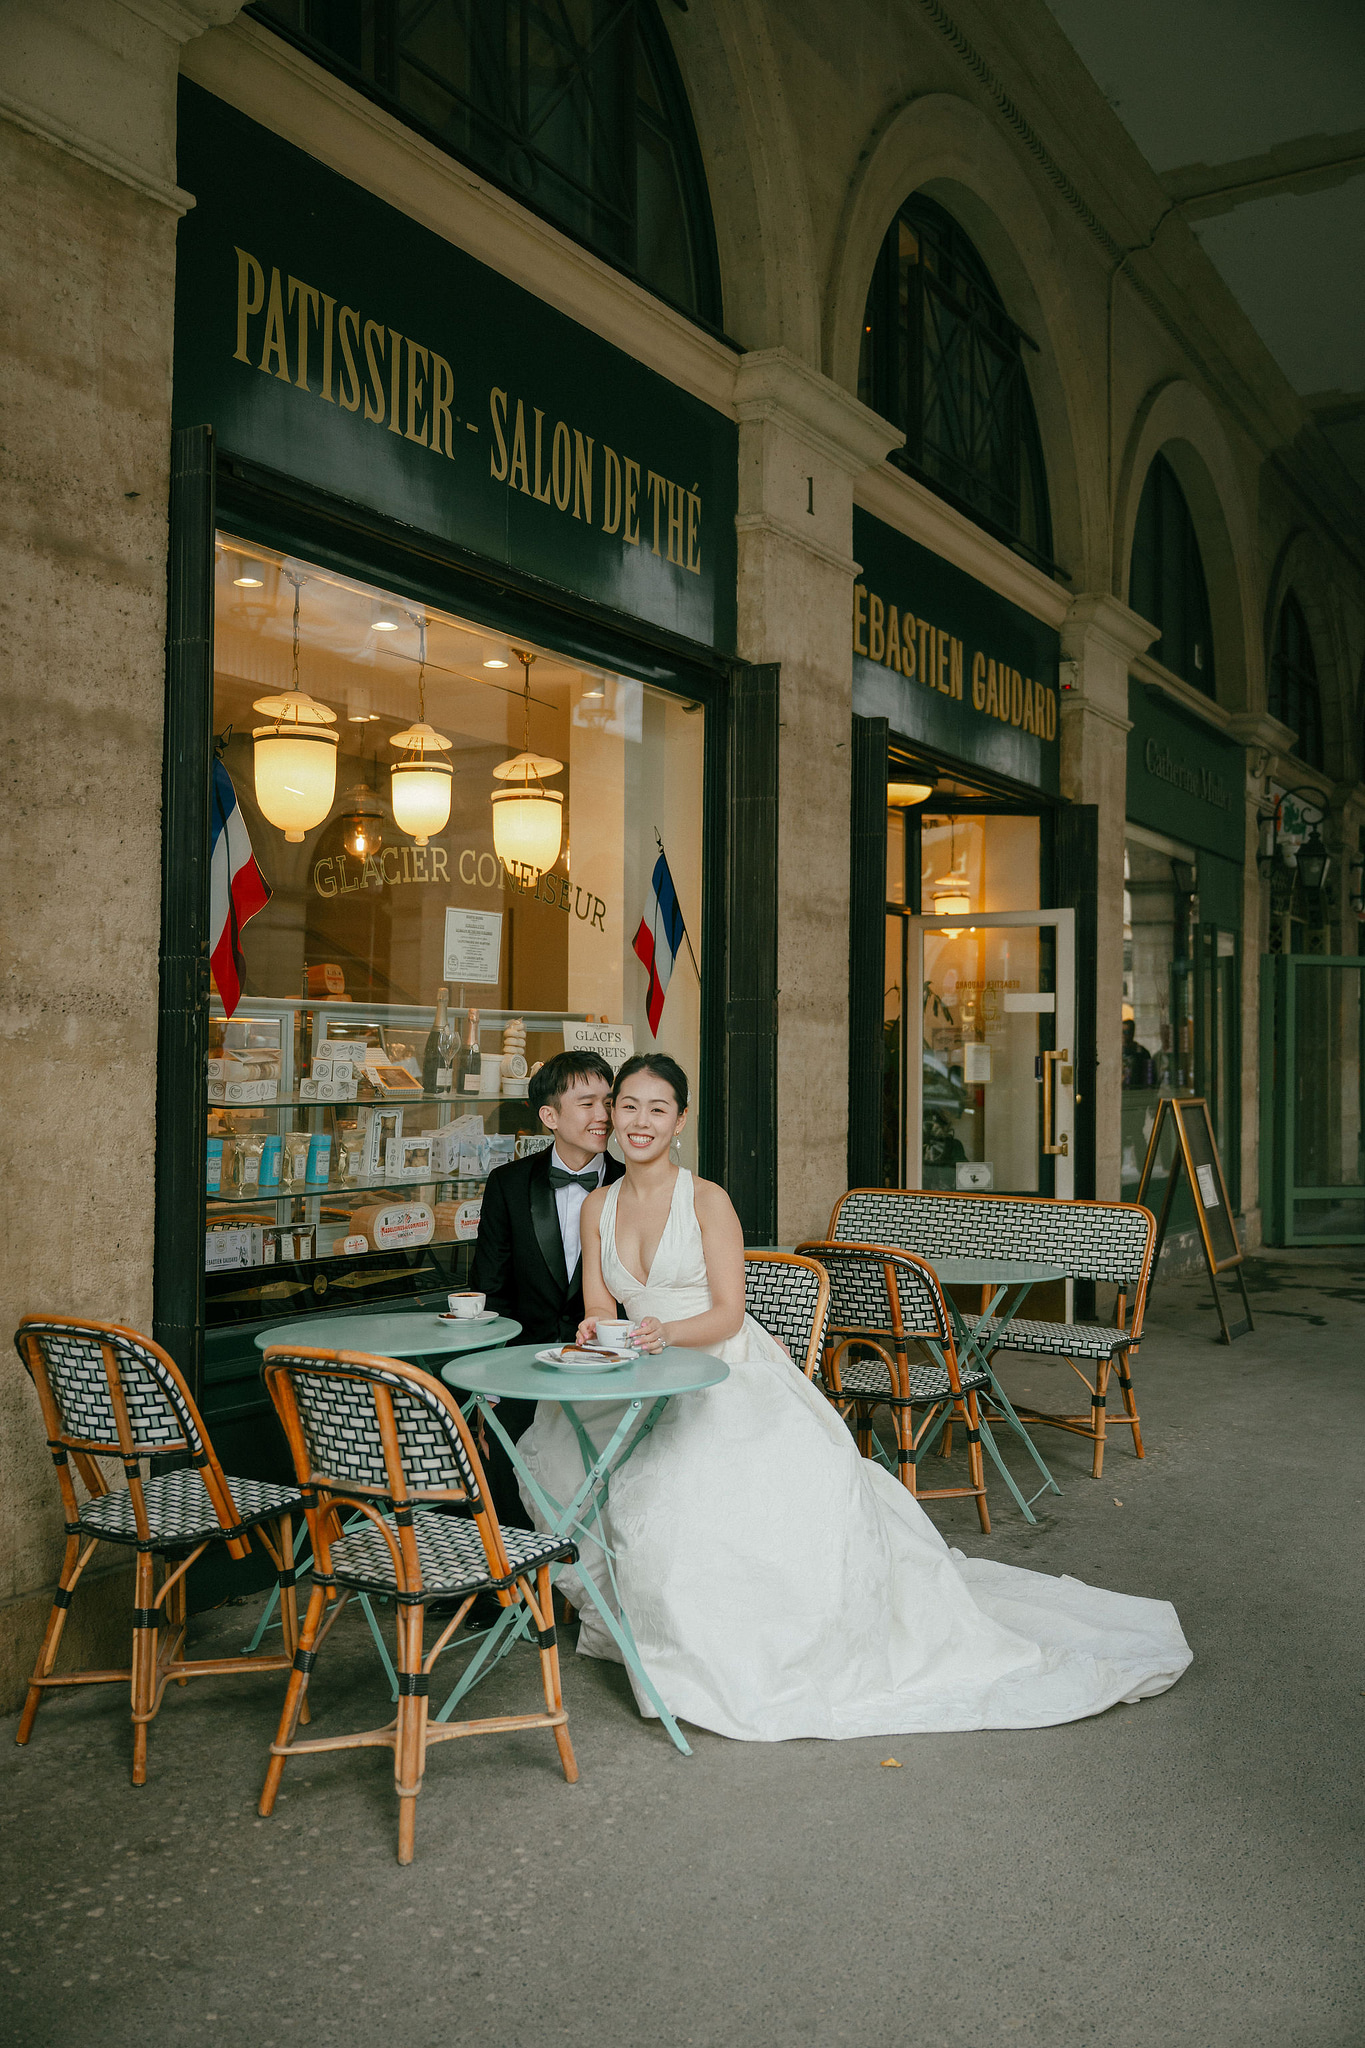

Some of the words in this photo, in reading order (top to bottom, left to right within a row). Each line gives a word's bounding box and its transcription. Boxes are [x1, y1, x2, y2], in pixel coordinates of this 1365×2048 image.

[232, 245, 456, 461] PATISSIER
[490, 386, 595, 525] SALON
[601, 444, 641, 546] DE
[647, 469, 702, 575] THÉ
[972, 651, 1057, 741] GAUDARD
[313, 846, 451, 898] GLACIER
[459, 849, 606, 932] CONFISEUR
